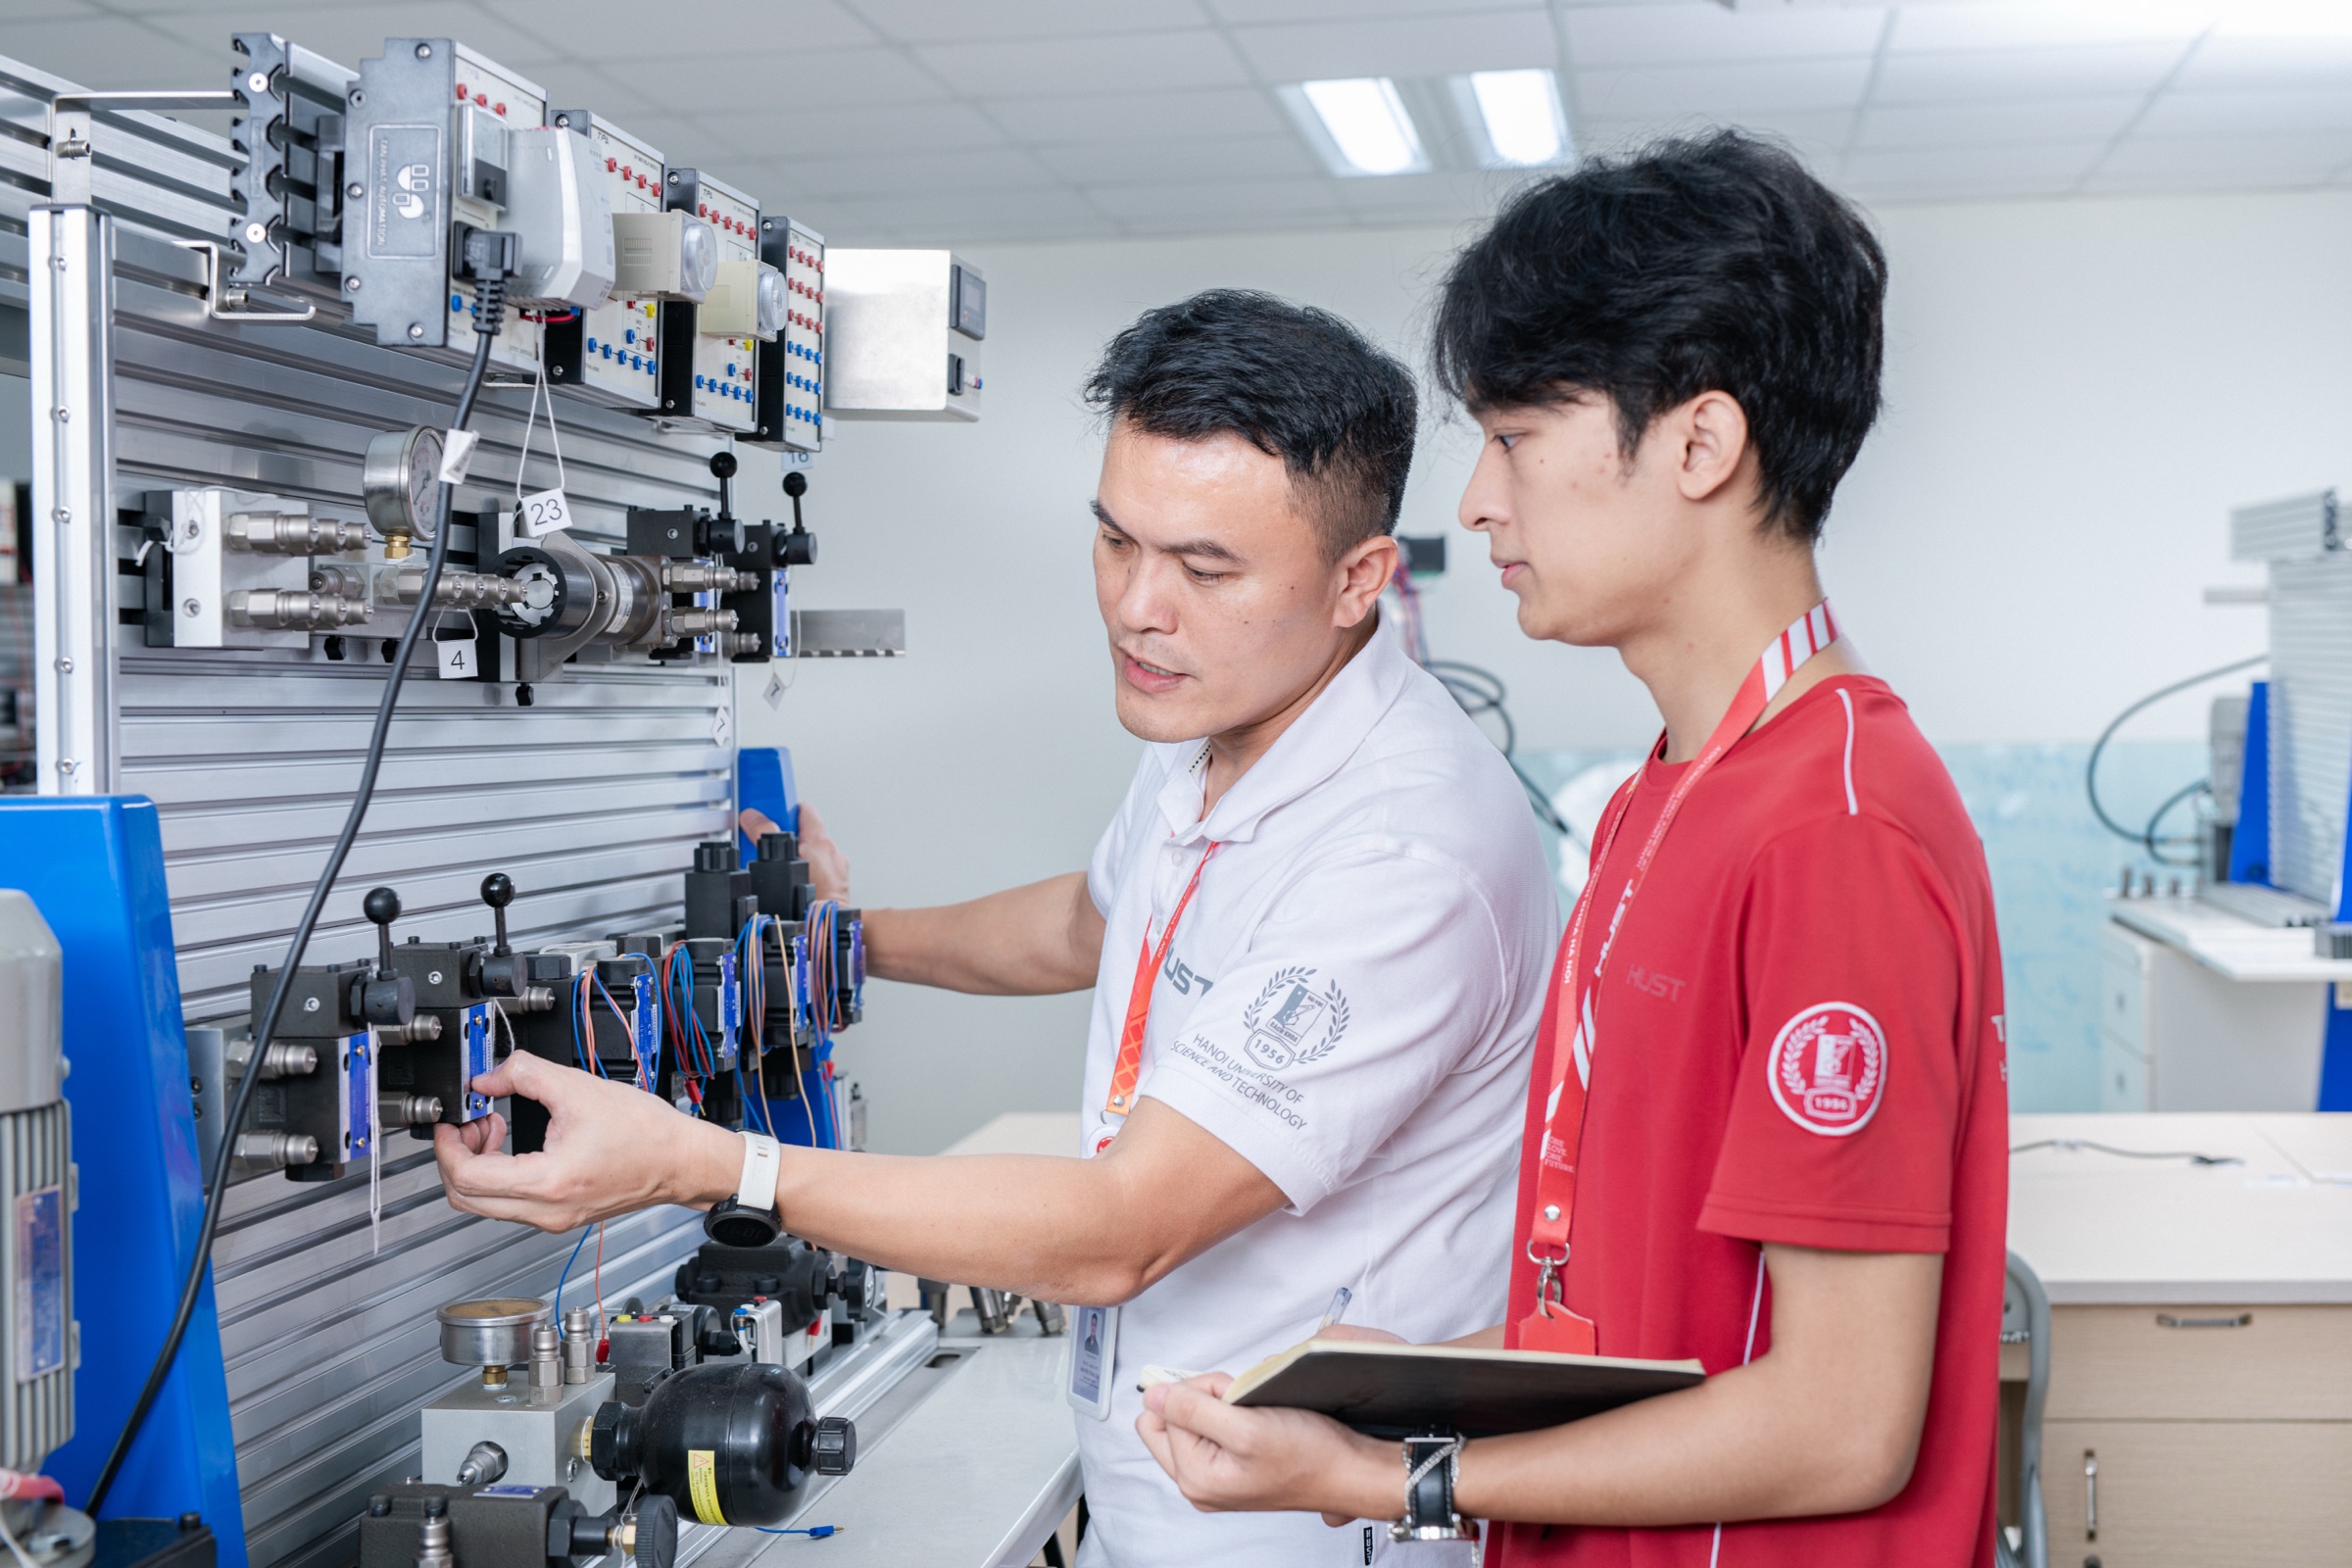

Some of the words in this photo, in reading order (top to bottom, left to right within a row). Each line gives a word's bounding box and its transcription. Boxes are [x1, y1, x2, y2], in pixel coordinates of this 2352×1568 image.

[530, 498, 563, 526] 23
[450, 651, 466, 671] 4
[716, 717, 726, 733] 7
[1677, 746, 1722, 799] TECHNOLOGY
[1594, 879, 1634, 978] HUST
[1625, 962, 1687, 1004] HUST
[1254, 1039, 1285, 1064] 1956
[1284, 1029, 1298, 1043] KHOA
[1170, 1040, 1212, 1068] SCIENCE
[1207, 1064, 1234, 1082] AND
[1232, 1076, 1307, 1130] TECHNOLOGY
[1193, 1033, 1230, 1064] HANOI
[1227, 1059, 1289, 1094] UNIVERSITY
[1286, 1089, 1304, 1103] OF
